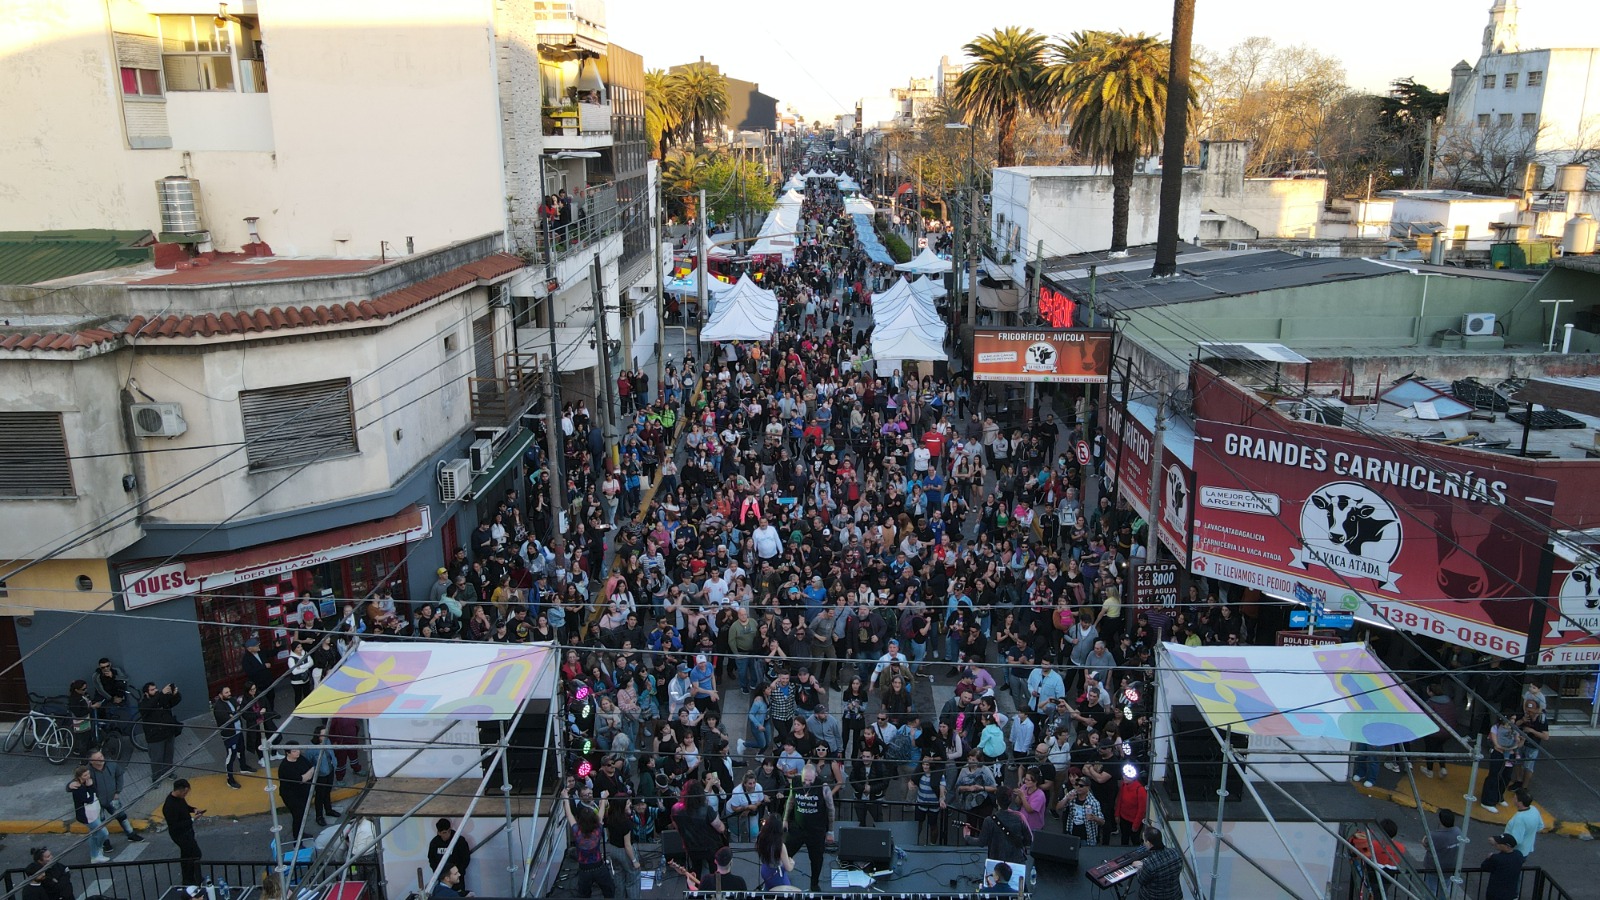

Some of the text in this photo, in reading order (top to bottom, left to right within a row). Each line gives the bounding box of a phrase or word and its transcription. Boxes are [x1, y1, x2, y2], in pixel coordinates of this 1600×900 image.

[998, 332, 1085, 342] FRIGORÍFICO AVÍCOLA
[1224, 433, 1507, 506] GRANDES CARNICERÍAS
[1207, 498, 1272, 511] ARGENTINA
[1218, 492, 1243, 500] MEJOR
[1245, 495, 1273, 504] CARNE
[1238, 544, 1246, 553] LA
[1246, 547, 1262, 557] VACA
[234, 568, 265, 582] LIDER
[268, 566, 282, 576] EN
[285, 562, 298, 571] LA
[300, 555, 328, 567] ZONA
[1137, 564, 1177, 572] FALDA
[1309, 551, 1380, 576] LA VACA ATADA
[134, 570, 208, 597] QUESO
[1152, 572, 1174, 586] 8000
[1214, 562, 1222, 575] TE
[1223, 565, 1256, 584] LLEVAMOS
[1257, 575, 1265, 587] EL
[1266, 576, 1291, 593] PEDIDO
[1579, 617, 1598, 627] VACA
[1371, 603, 1521, 656] 113816-0866
[1283, 637, 1303, 645] BOLA
[1304, 638, 1314, 646] DE
[1560, 652, 1572, 661] TE
